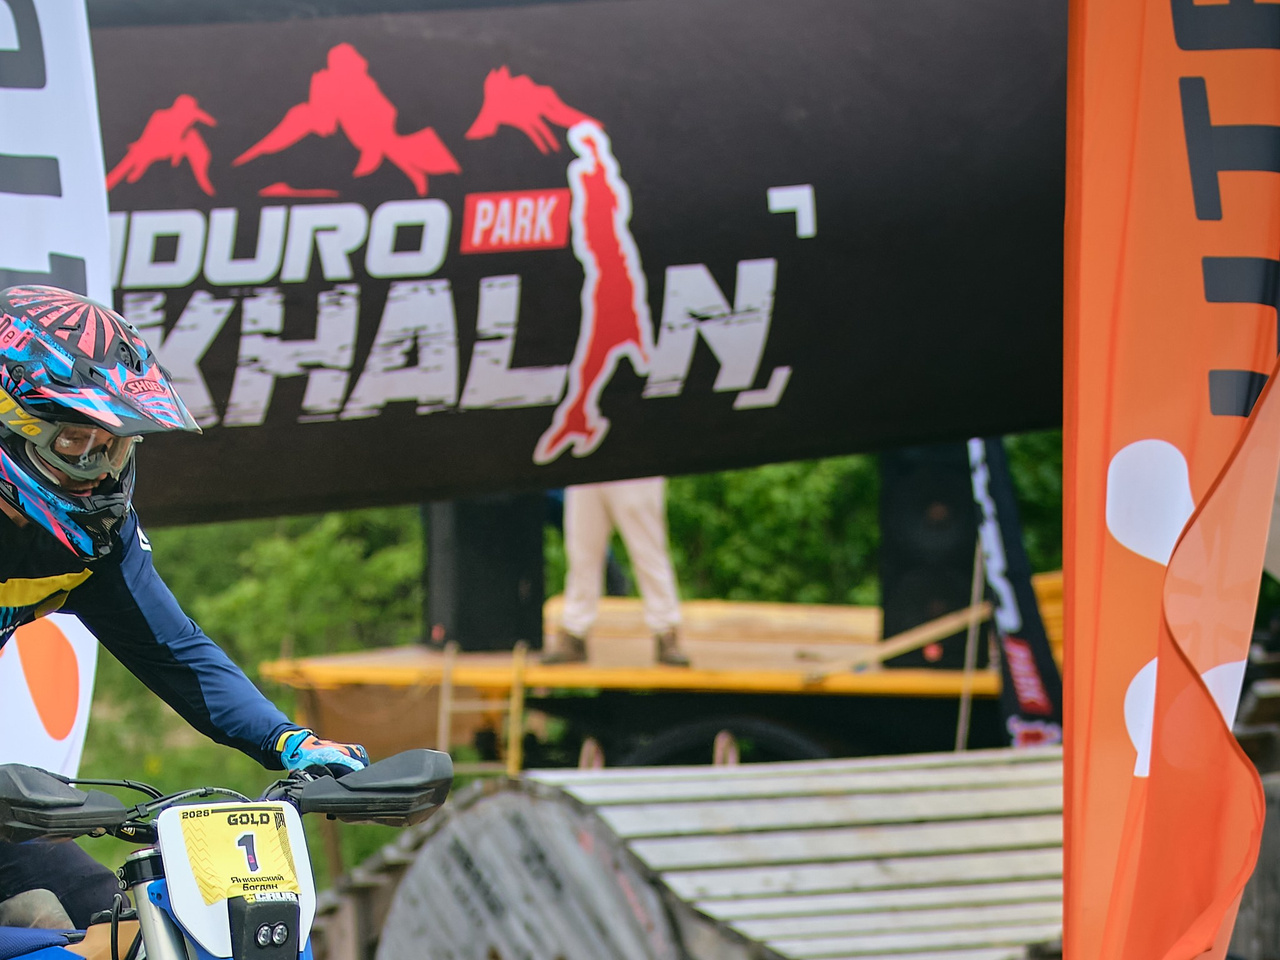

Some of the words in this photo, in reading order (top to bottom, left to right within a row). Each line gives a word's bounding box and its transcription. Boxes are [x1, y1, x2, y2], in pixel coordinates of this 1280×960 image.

[106, 197, 452, 290] DURO
[470, 195, 560, 247] PARK
[127, 380, 163, 394] SHOEI
[227, 812, 270, 827] GOLD
[237, 833, 260, 873] 1
